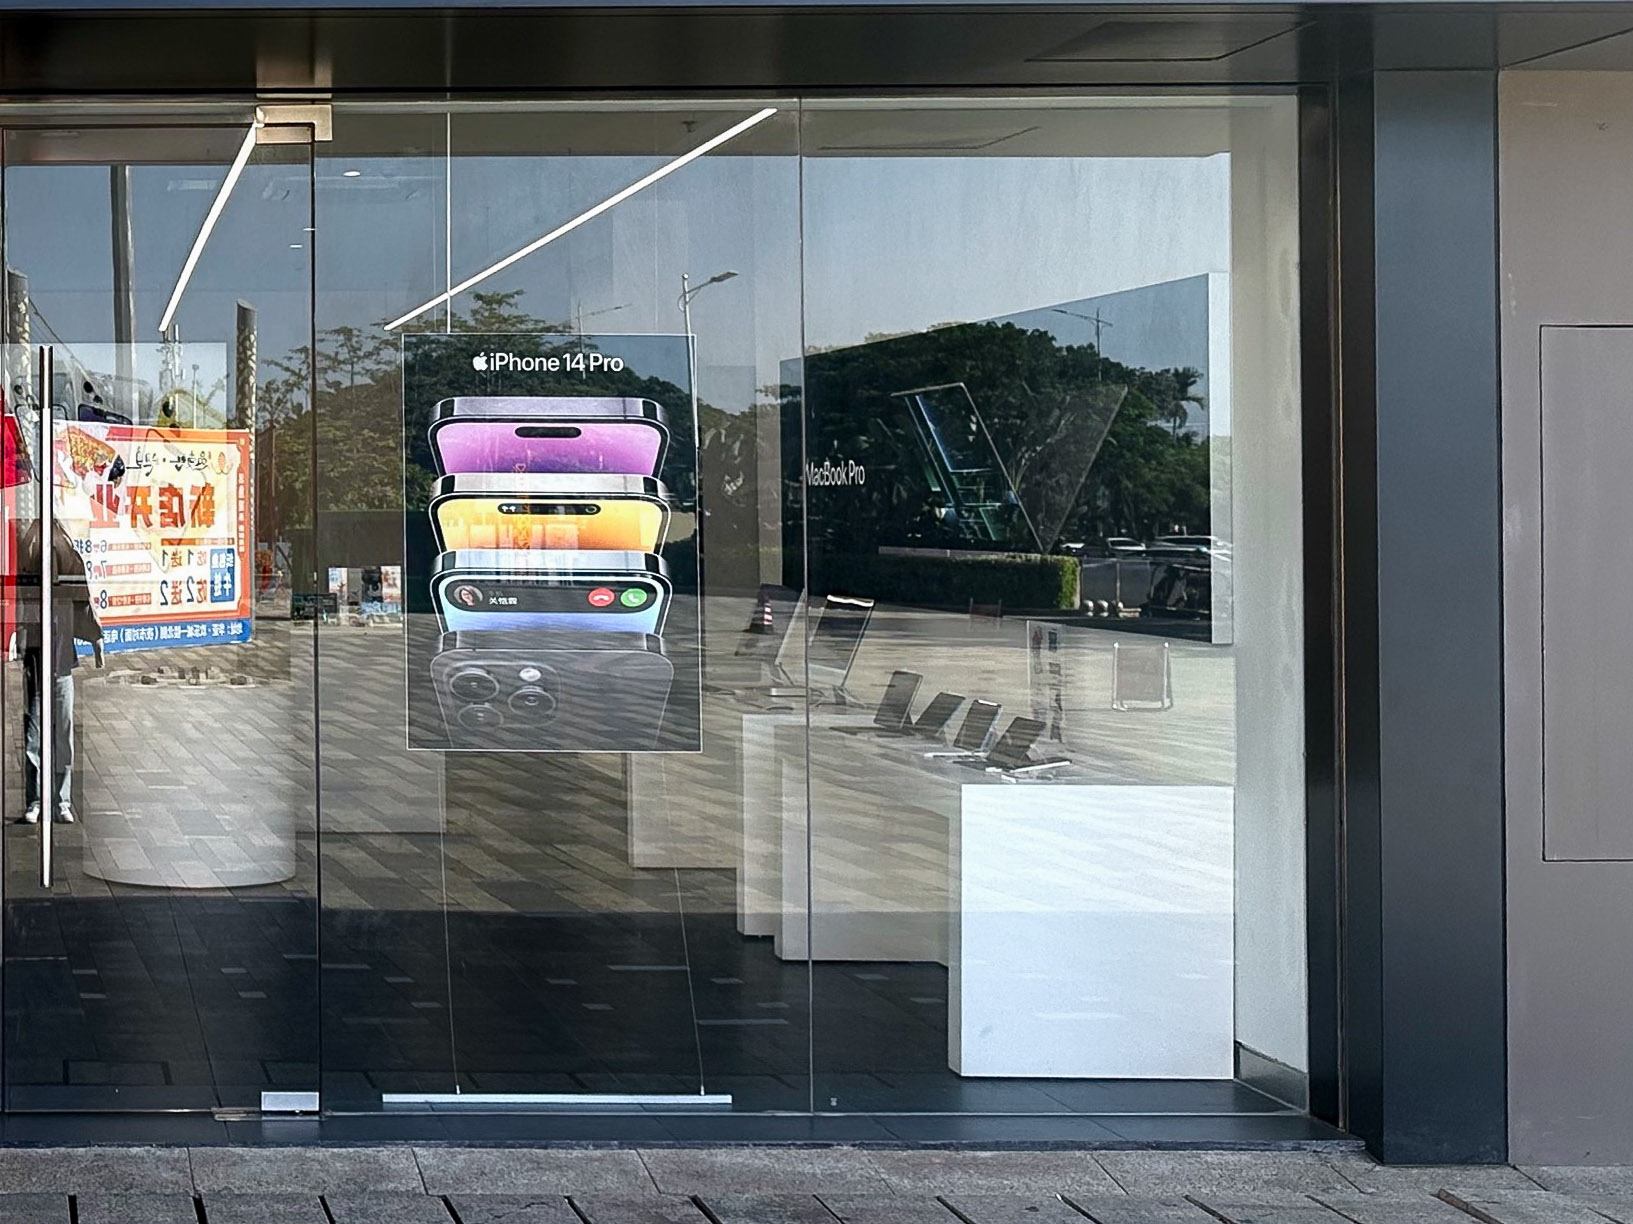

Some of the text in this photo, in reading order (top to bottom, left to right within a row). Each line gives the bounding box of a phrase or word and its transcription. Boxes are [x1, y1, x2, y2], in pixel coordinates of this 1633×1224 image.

[489, 353, 625, 373] iPhone 14 Pro
[805, 460, 866, 486] MacBook Pro
